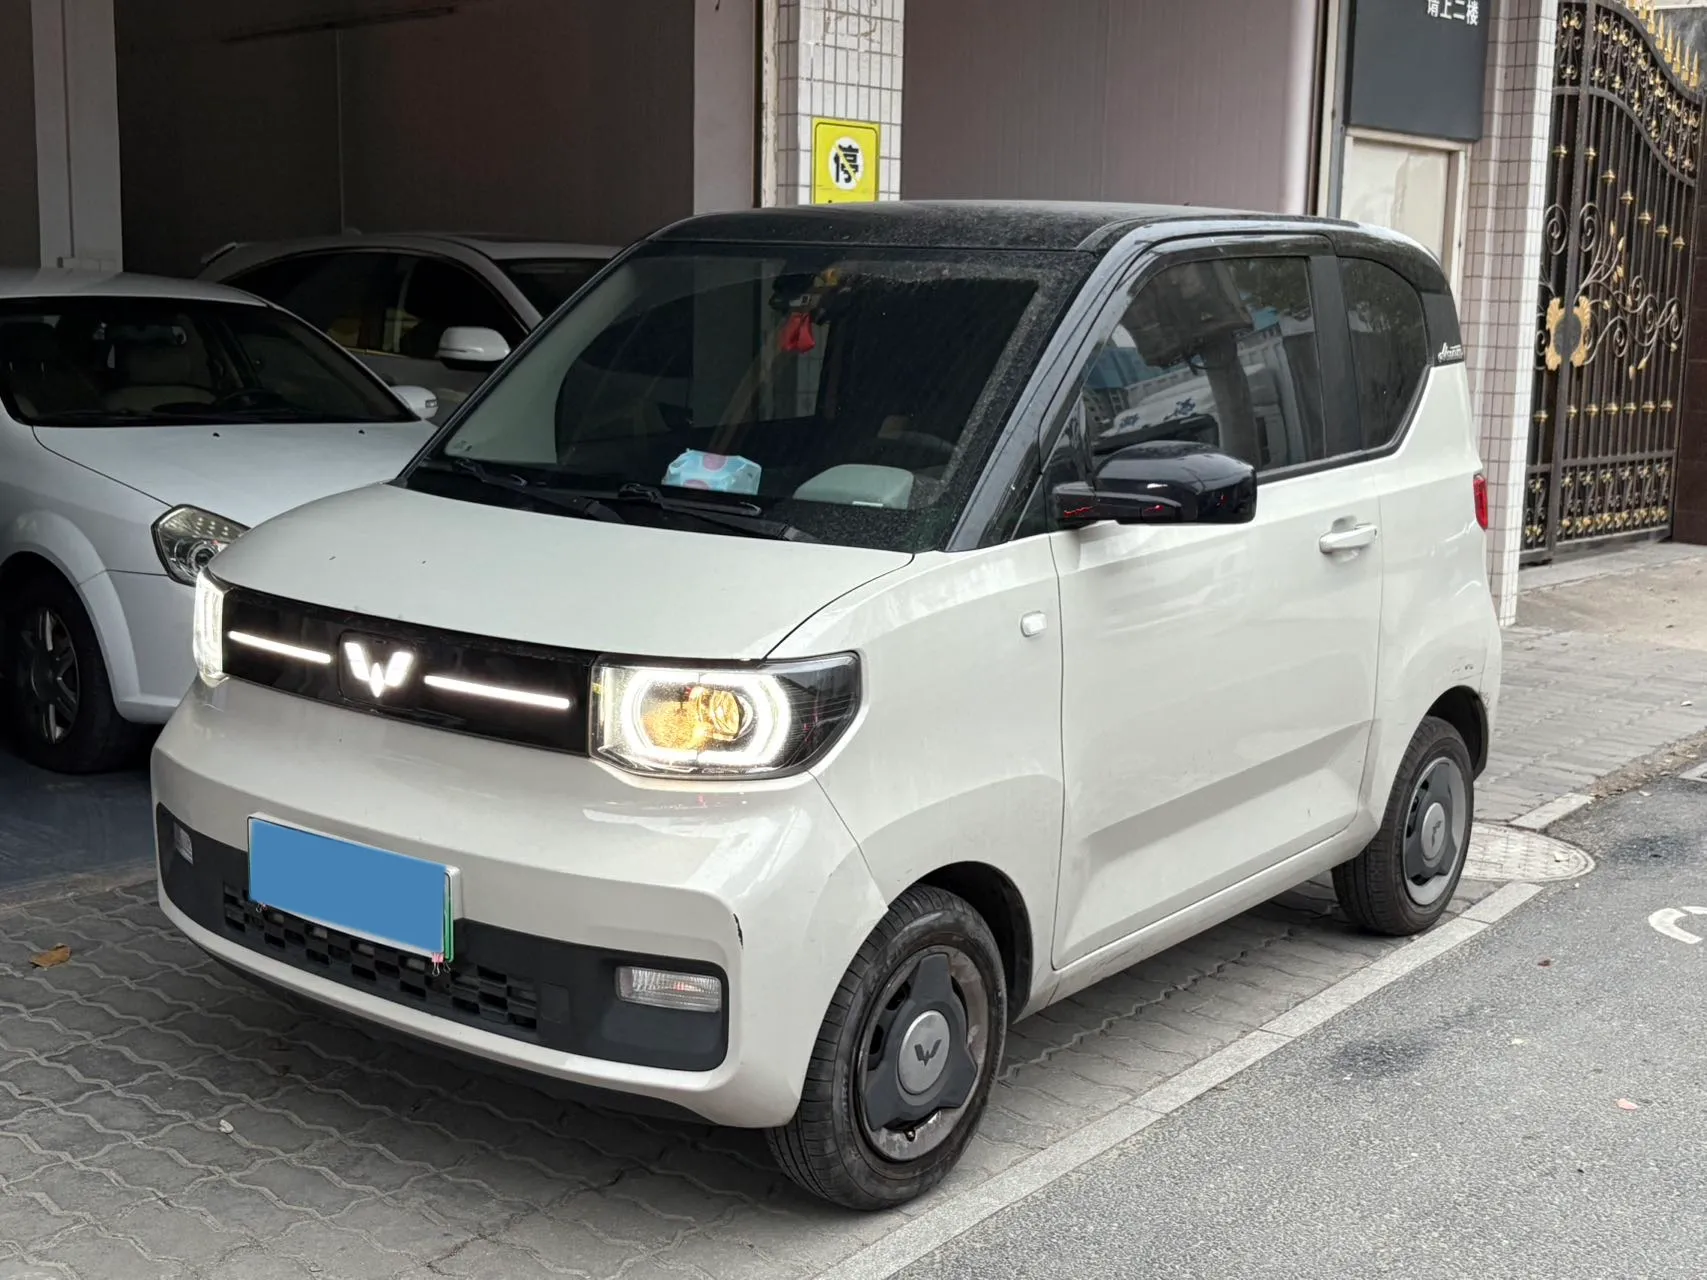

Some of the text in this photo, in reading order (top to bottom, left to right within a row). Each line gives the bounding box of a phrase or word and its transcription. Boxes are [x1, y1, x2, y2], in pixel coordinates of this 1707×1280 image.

[1427, 0, 1479, 26] 请上二楼
[833, 143, 860, 184] 停
